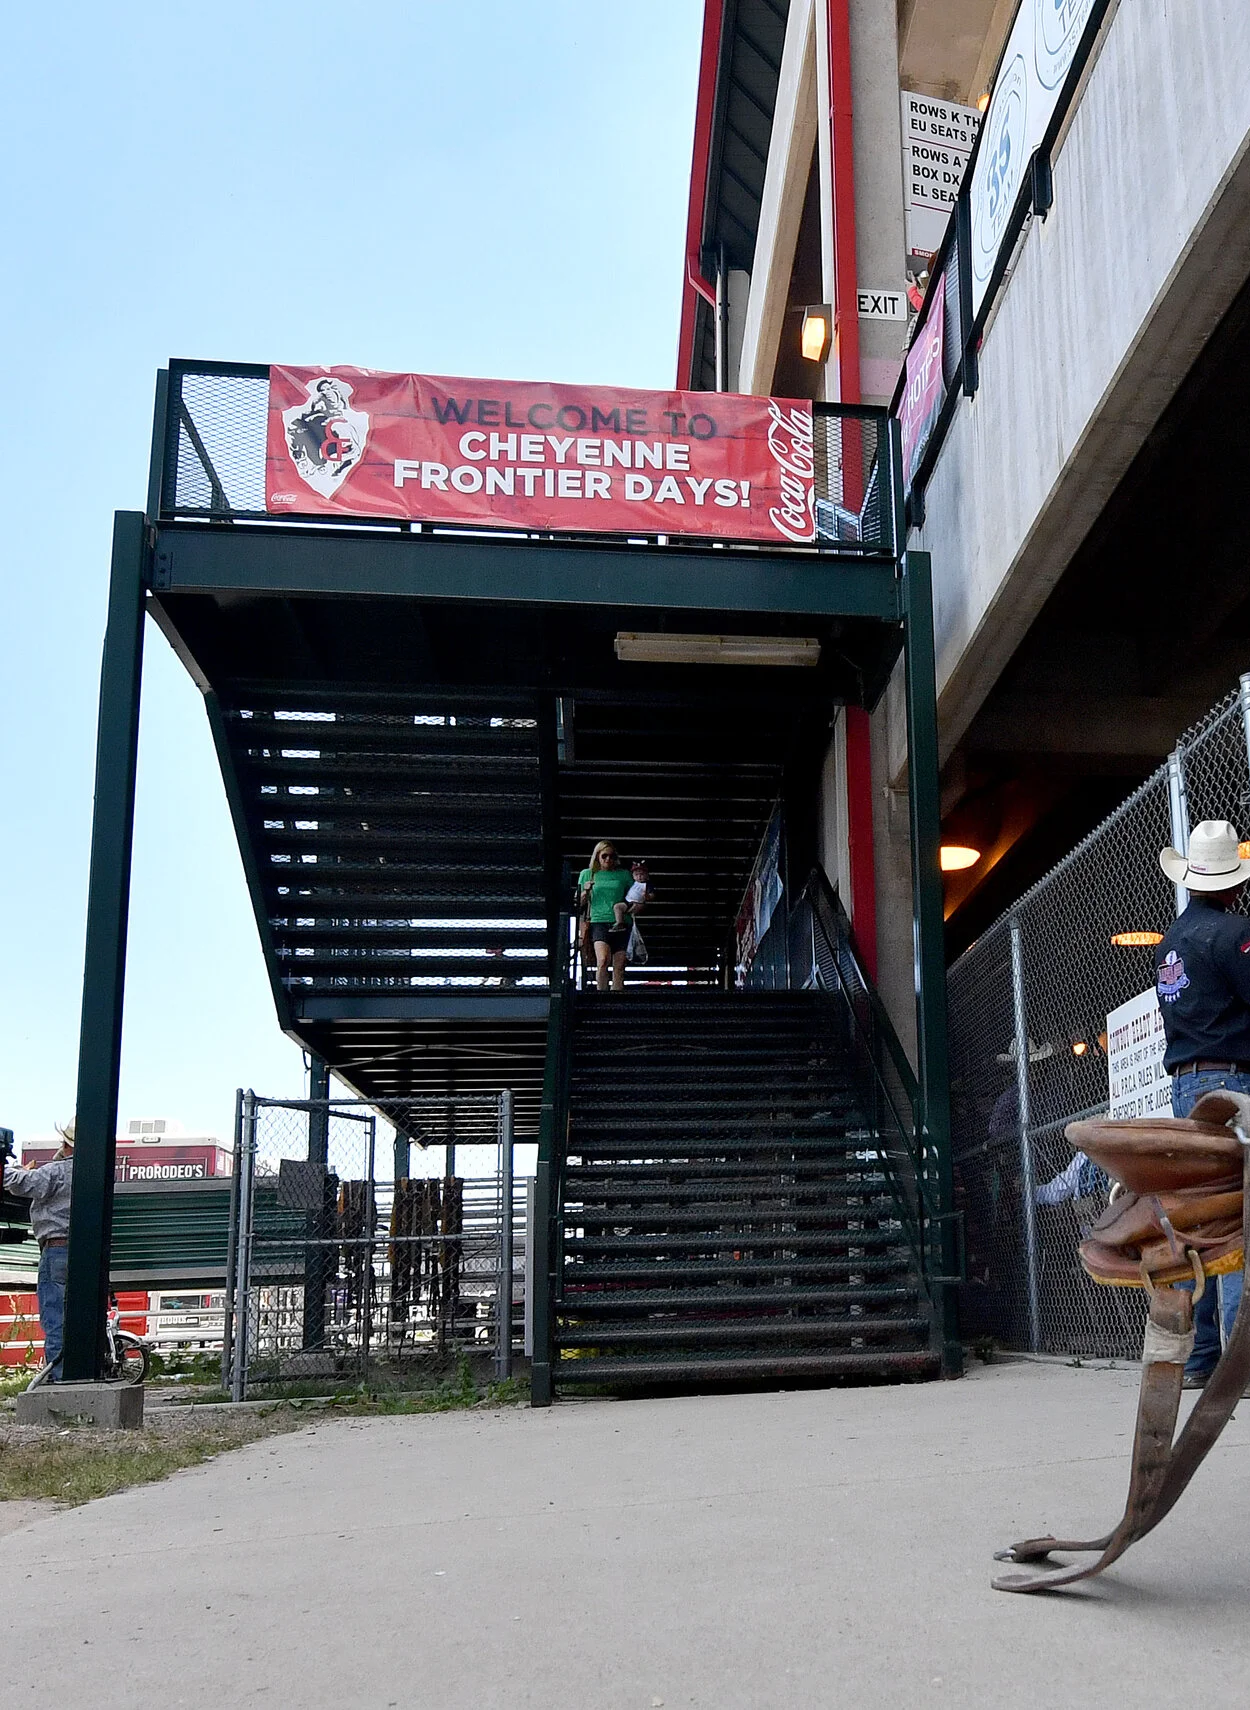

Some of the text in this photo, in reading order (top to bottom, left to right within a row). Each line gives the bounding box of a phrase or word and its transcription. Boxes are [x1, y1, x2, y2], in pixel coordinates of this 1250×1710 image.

[910, 100, 980, 128] ROWS K TH
[911, 118, 926, 132] EU
[930, 123, 967, 142] SEATS
[911, 145, 962, 168] ROWS A
[912, 164, 960, 187] BOX DX
[912, 183, 928, 197] EL
[857, 294, 899, 315] EXIT
[431, 397, 717, 440] WELCOME TO
[458, 431, 690, 471] CHEYENNE
[767, 397, 815, 542] Coca-Cola
[393, 459, 751, 507] FRONTIER DAYS!
[1138, 1065, 1153, 1088] RULES
[1144, 1092, 1154, 1111] THE
[129, 1164, 204, 1180] PRORODEO'S
